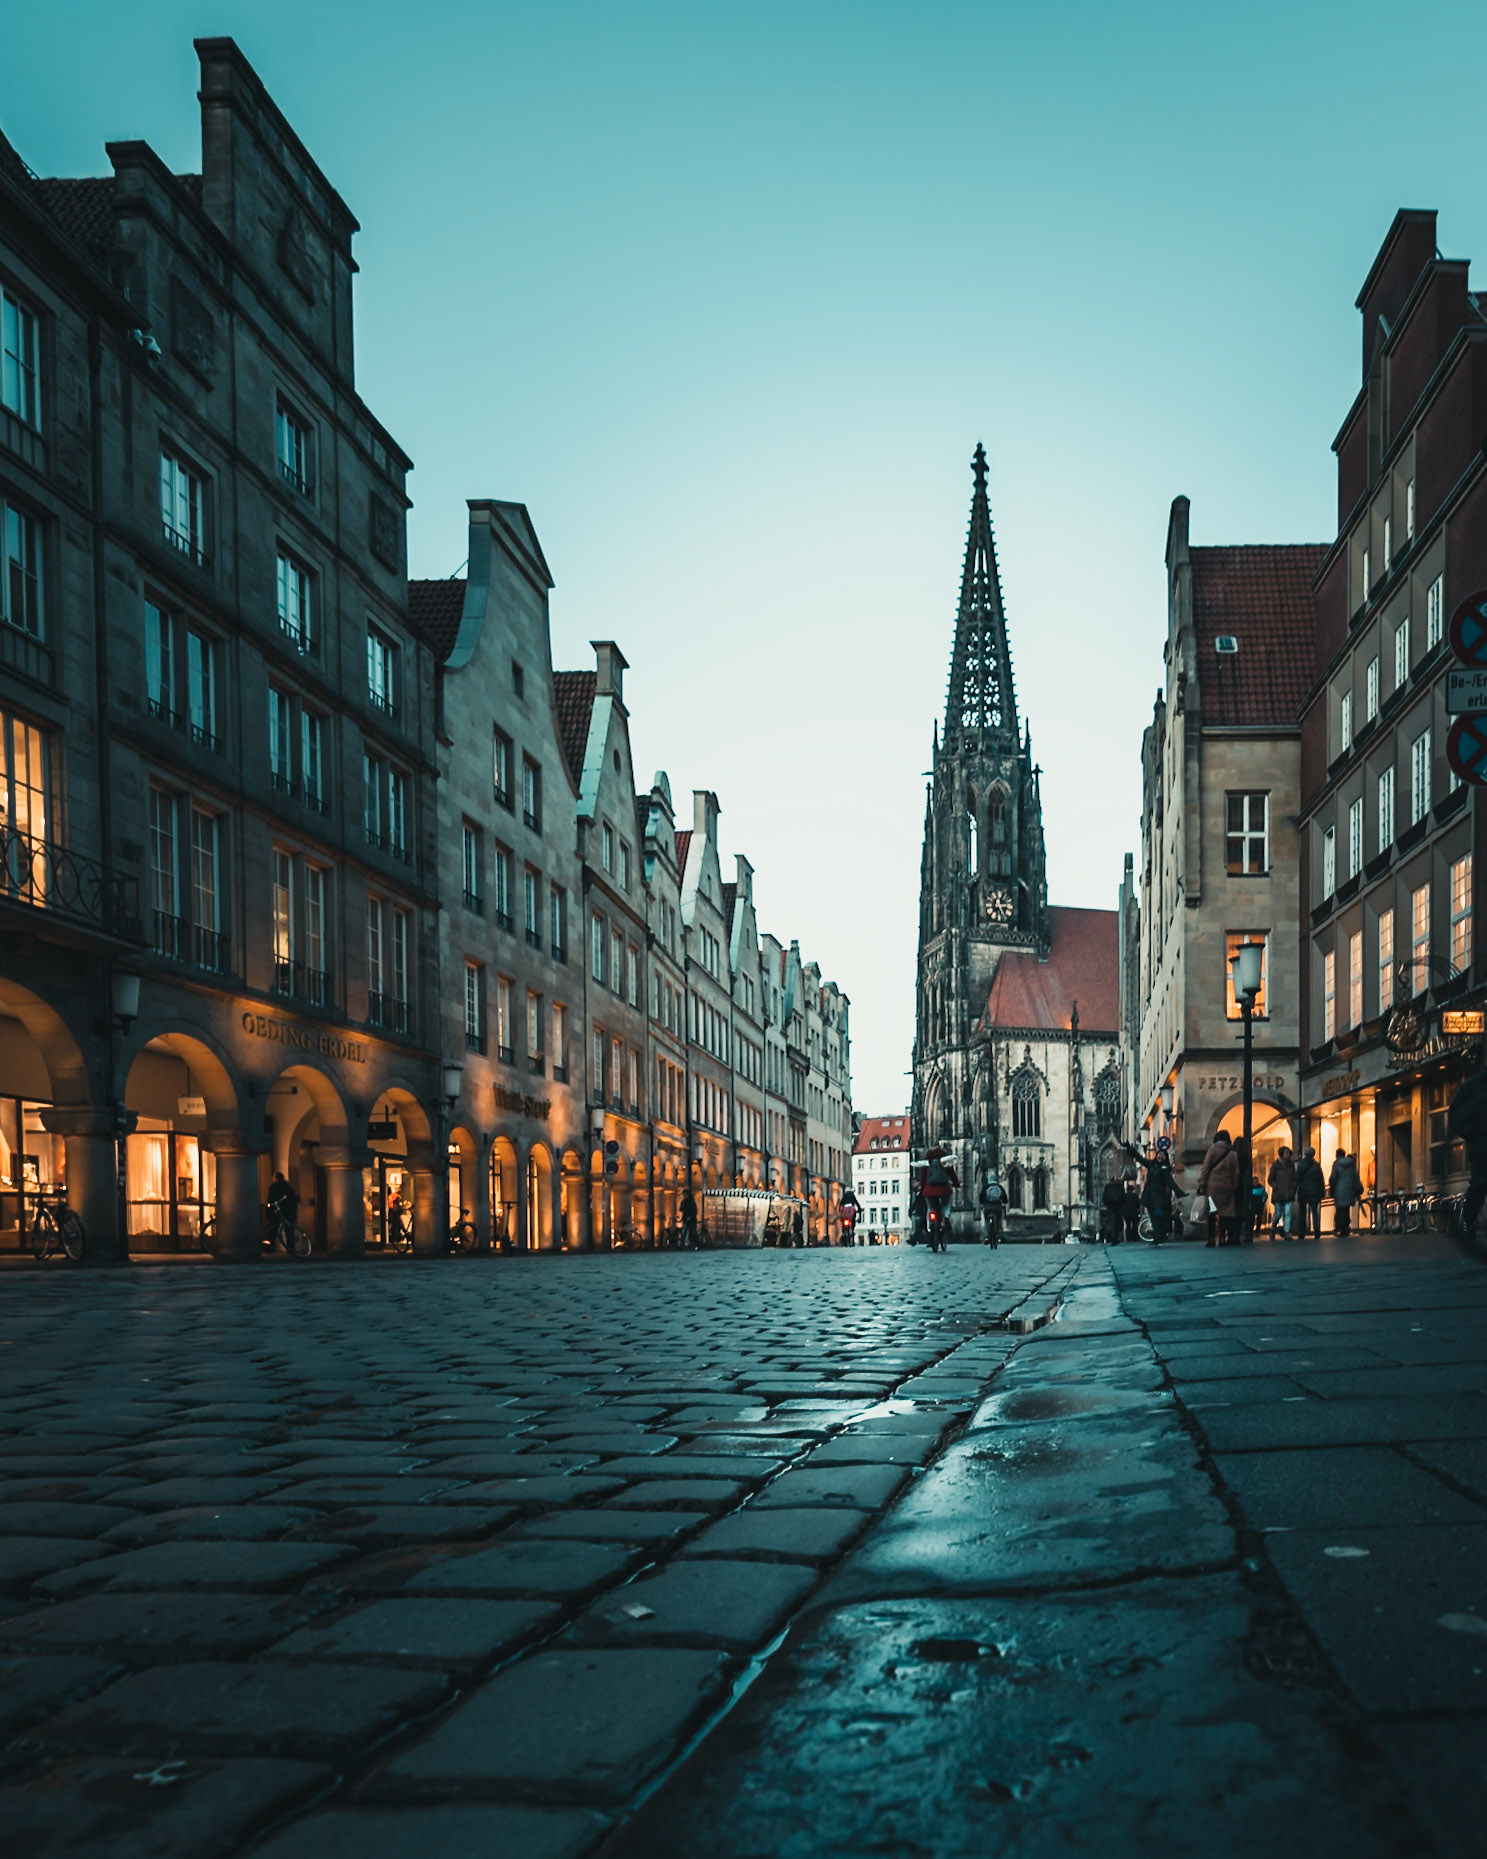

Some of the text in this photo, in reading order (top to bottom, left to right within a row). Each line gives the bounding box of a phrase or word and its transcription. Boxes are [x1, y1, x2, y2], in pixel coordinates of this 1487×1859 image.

[242, 1012, 367, 1063] OEDING ERDEL
[1198, 1076, 1284, 1090] PETZOLD
